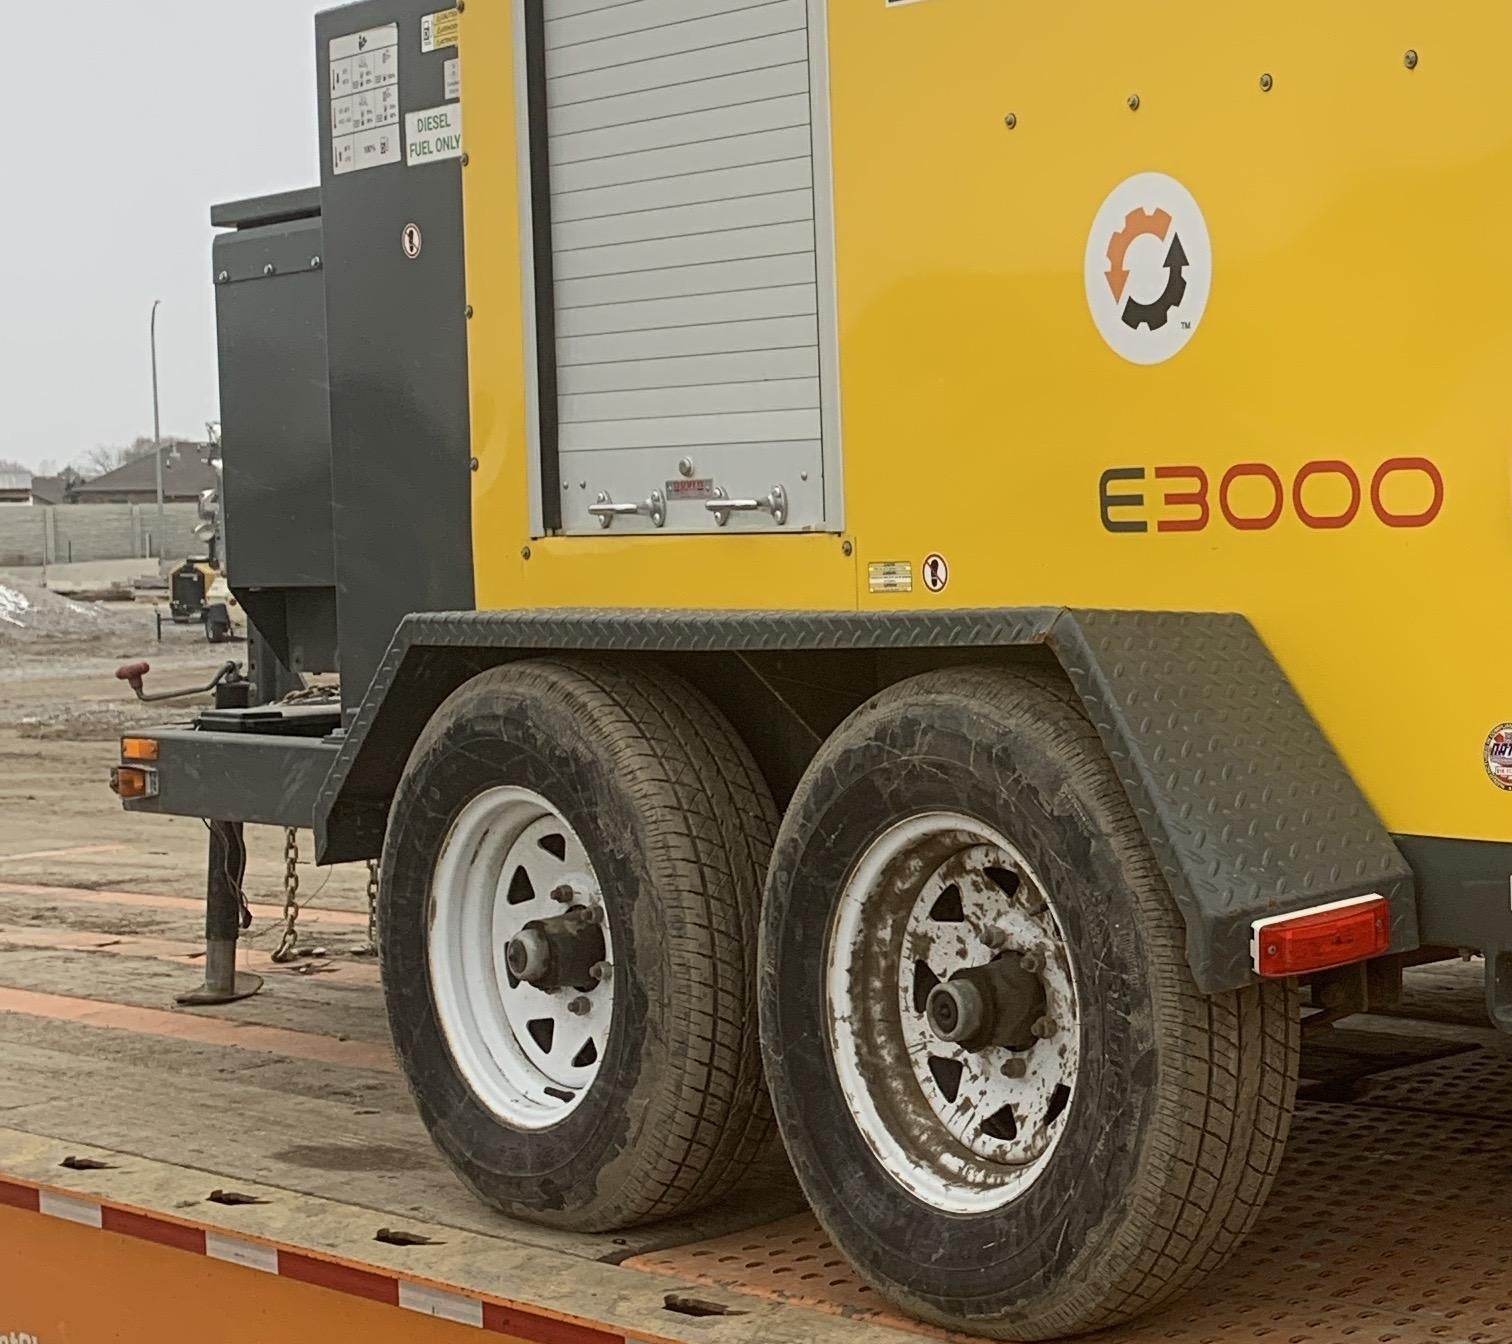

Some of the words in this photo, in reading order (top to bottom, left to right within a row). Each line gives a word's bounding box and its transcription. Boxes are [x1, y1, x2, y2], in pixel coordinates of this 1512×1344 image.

[416, 113, 451, 133] DIESEL
[409, 140, 433, 158] FUEL
[435, 133, 461, 153] ONLY
[1099, 457, 1444, 533] E3000
